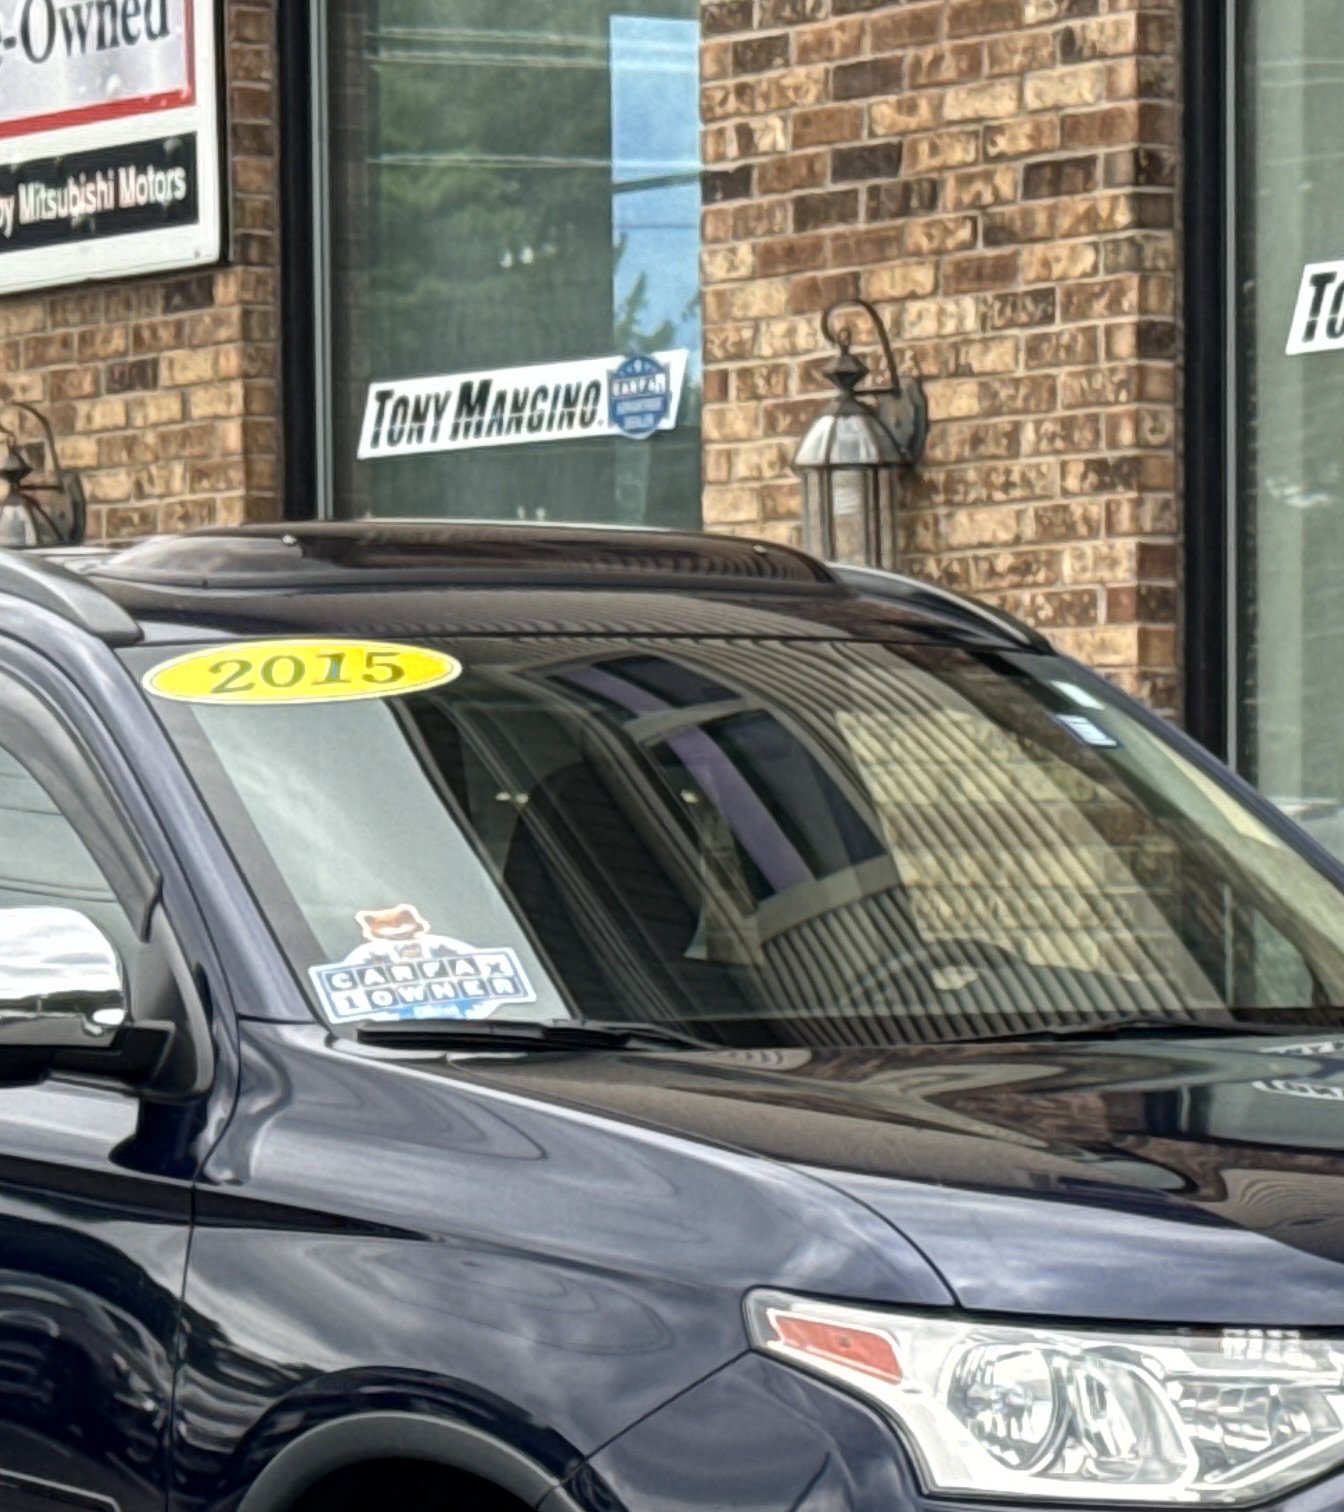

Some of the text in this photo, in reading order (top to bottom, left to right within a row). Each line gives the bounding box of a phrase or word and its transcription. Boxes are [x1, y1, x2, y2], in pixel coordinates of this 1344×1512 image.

[18, 169, 115, 225] Mitsubishi
[118, 163, 186, 209] Motors
[370, 389, 452, 449] TONY
[208, 650, 405, 694] 2015
[330, 959, 506, 990] CARFAX
[371, 977, 516, 1008] OWNER
